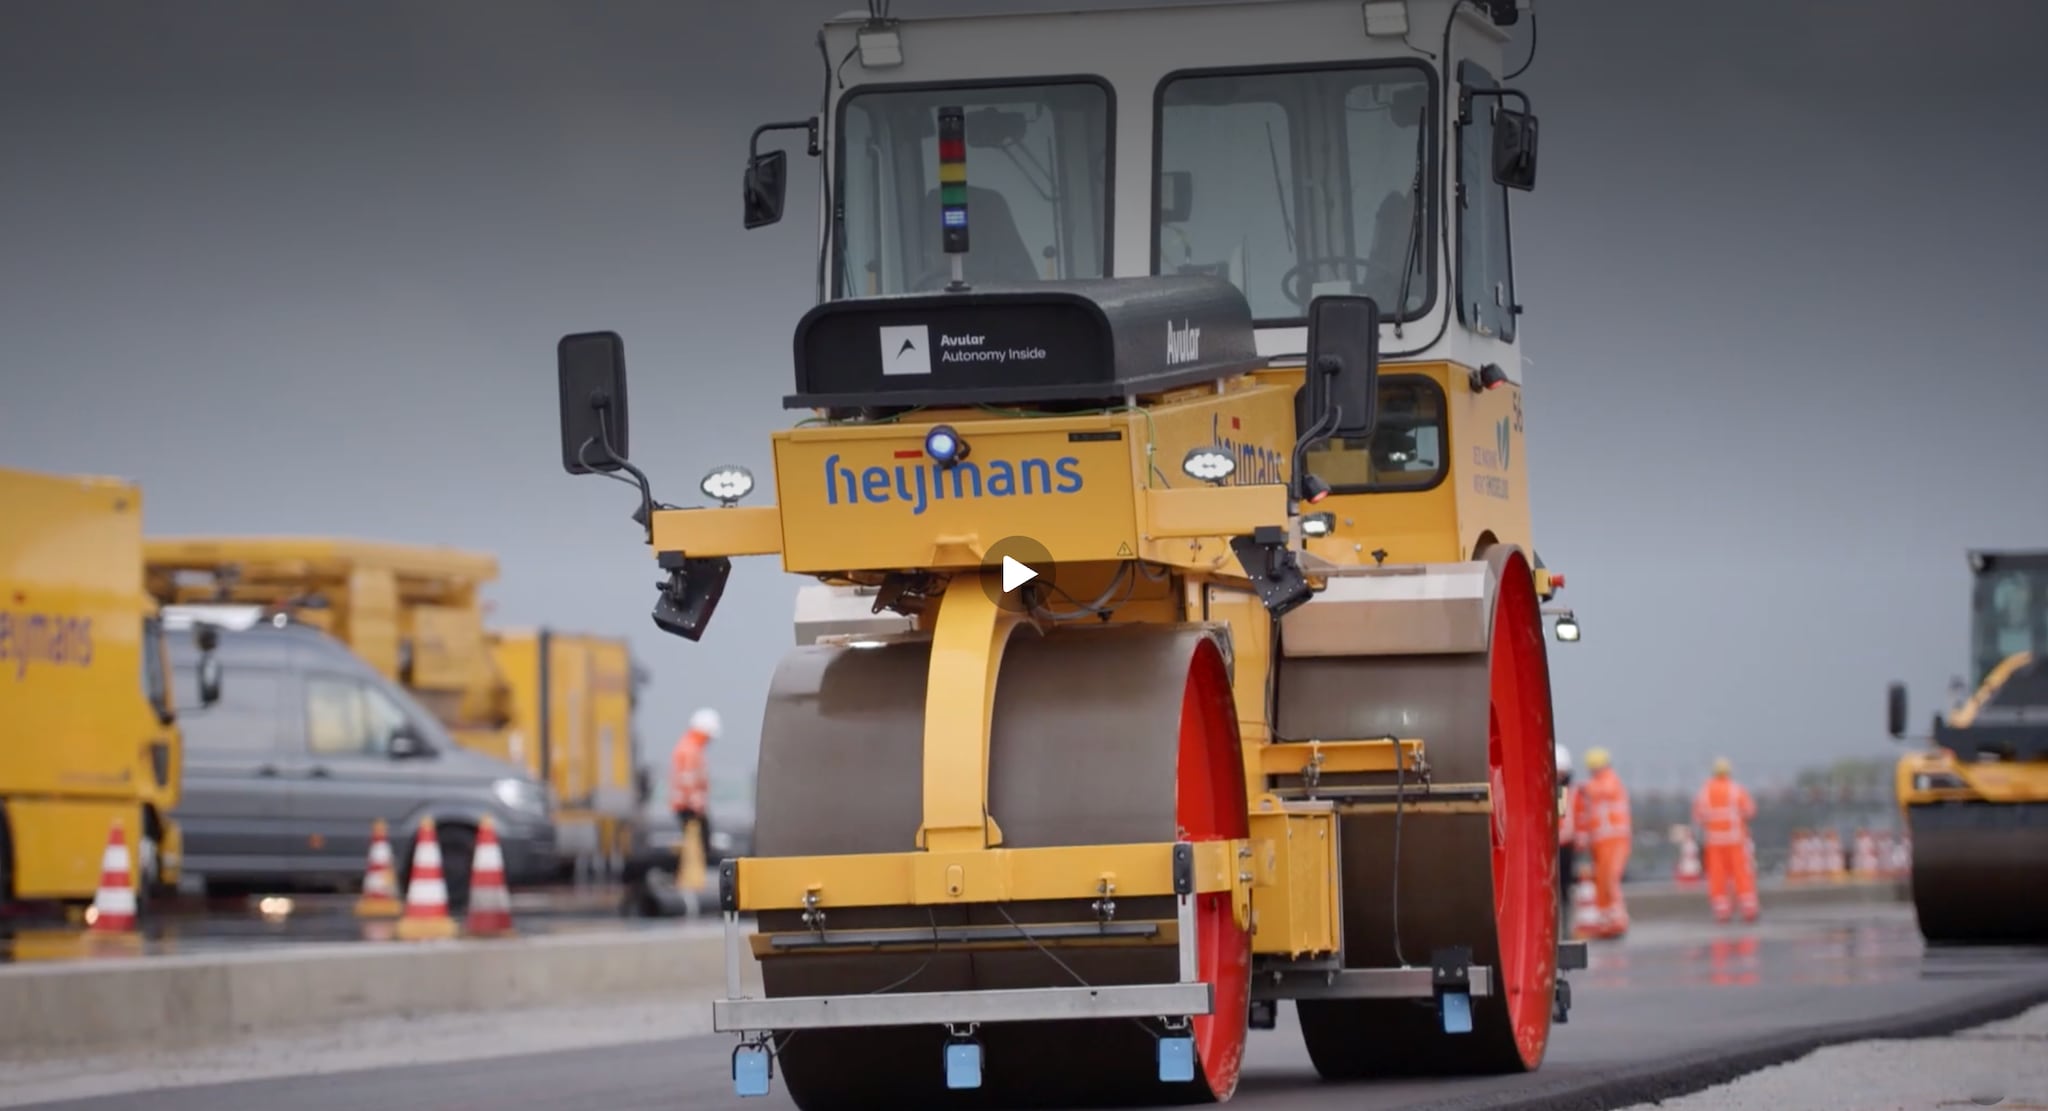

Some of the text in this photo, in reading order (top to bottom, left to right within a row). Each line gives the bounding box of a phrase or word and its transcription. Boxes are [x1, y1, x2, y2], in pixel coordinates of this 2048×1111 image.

[940, 334, 985, 347] Avular
[942, 347, 1046, 363] Autonomy Inside
[1167, 317, 1200, 365] Avular
[824, 450, 1083, 515] heijmans
[0, 591, 95, 682] eijmans
